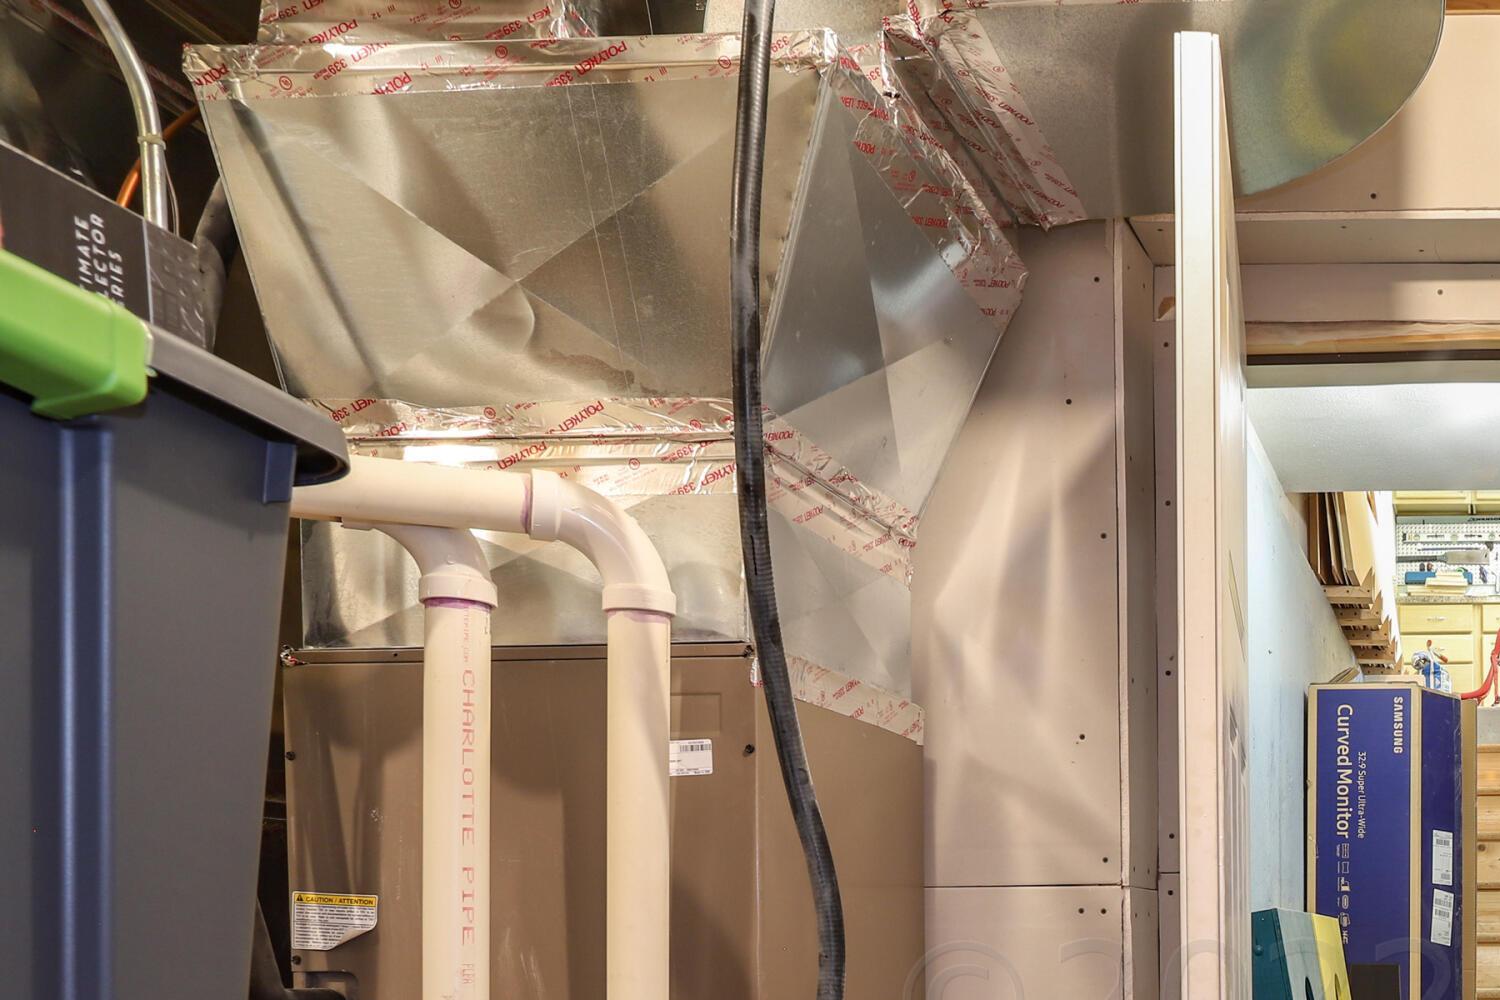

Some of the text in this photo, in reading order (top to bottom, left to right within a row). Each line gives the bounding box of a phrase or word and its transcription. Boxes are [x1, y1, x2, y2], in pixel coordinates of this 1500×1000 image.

[574, 40, 629, 75] POLYKEN
[559, 400, 605, 433] POLYKEN
[498, 440, 548, 471] POLYKEN
[1336, 704, 1354, 767] Curved
[1393, 696, 1404, 754] SAMSUNG
[463, 669, 475, 847] CHARLOTTE
[1357, 770, 1367, 792] Super
[1336, 768, 1353, 839] Monitor
[1357, 793, 1367, 839] Ultra-Wide
[338, 897, 374, 905] ATTENTION
[462, 867, 475, 947] PIPE
